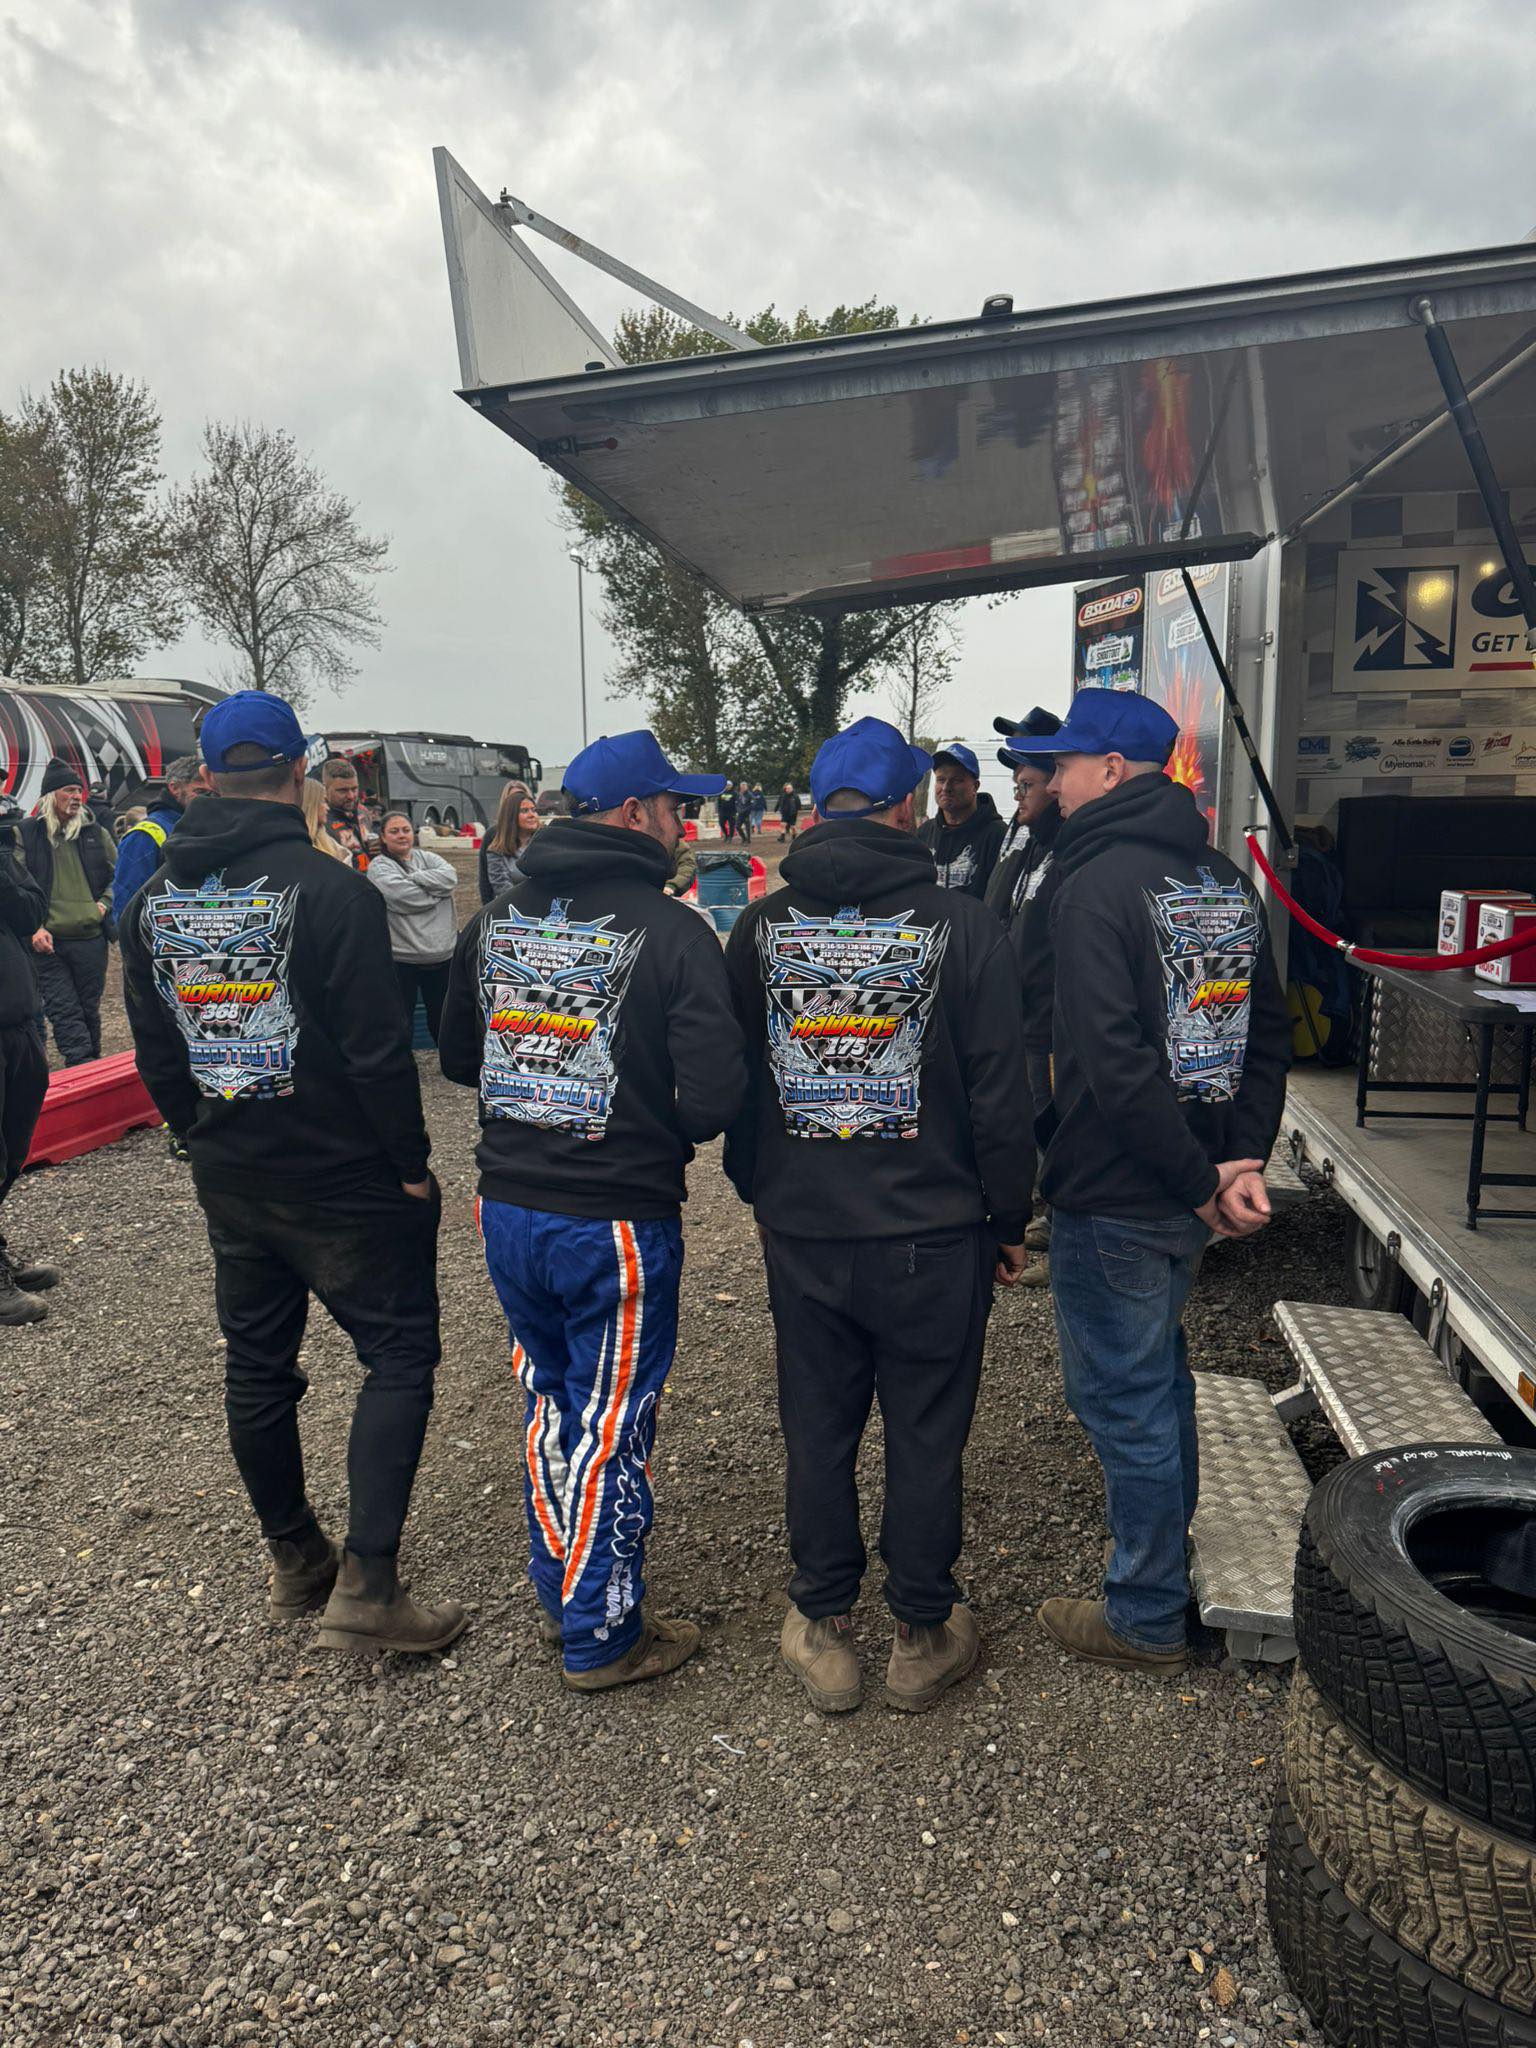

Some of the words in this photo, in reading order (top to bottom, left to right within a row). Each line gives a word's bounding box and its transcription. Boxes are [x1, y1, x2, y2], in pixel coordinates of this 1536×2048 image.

[1472, 632, 1519, 653] GET
[202, 1002, 240, 1020] 368
[802, 994, 856, 1019] Karl
[790, 1014, 904, 1040] HAWKINS
[515, 1034, 562, 1057] 212
[824, 1036, 868, 1058] 175
[485, 1071, 605, 1109] SHOOTOUT
[783, 1074, 912, 1108] SHOOTOUT
